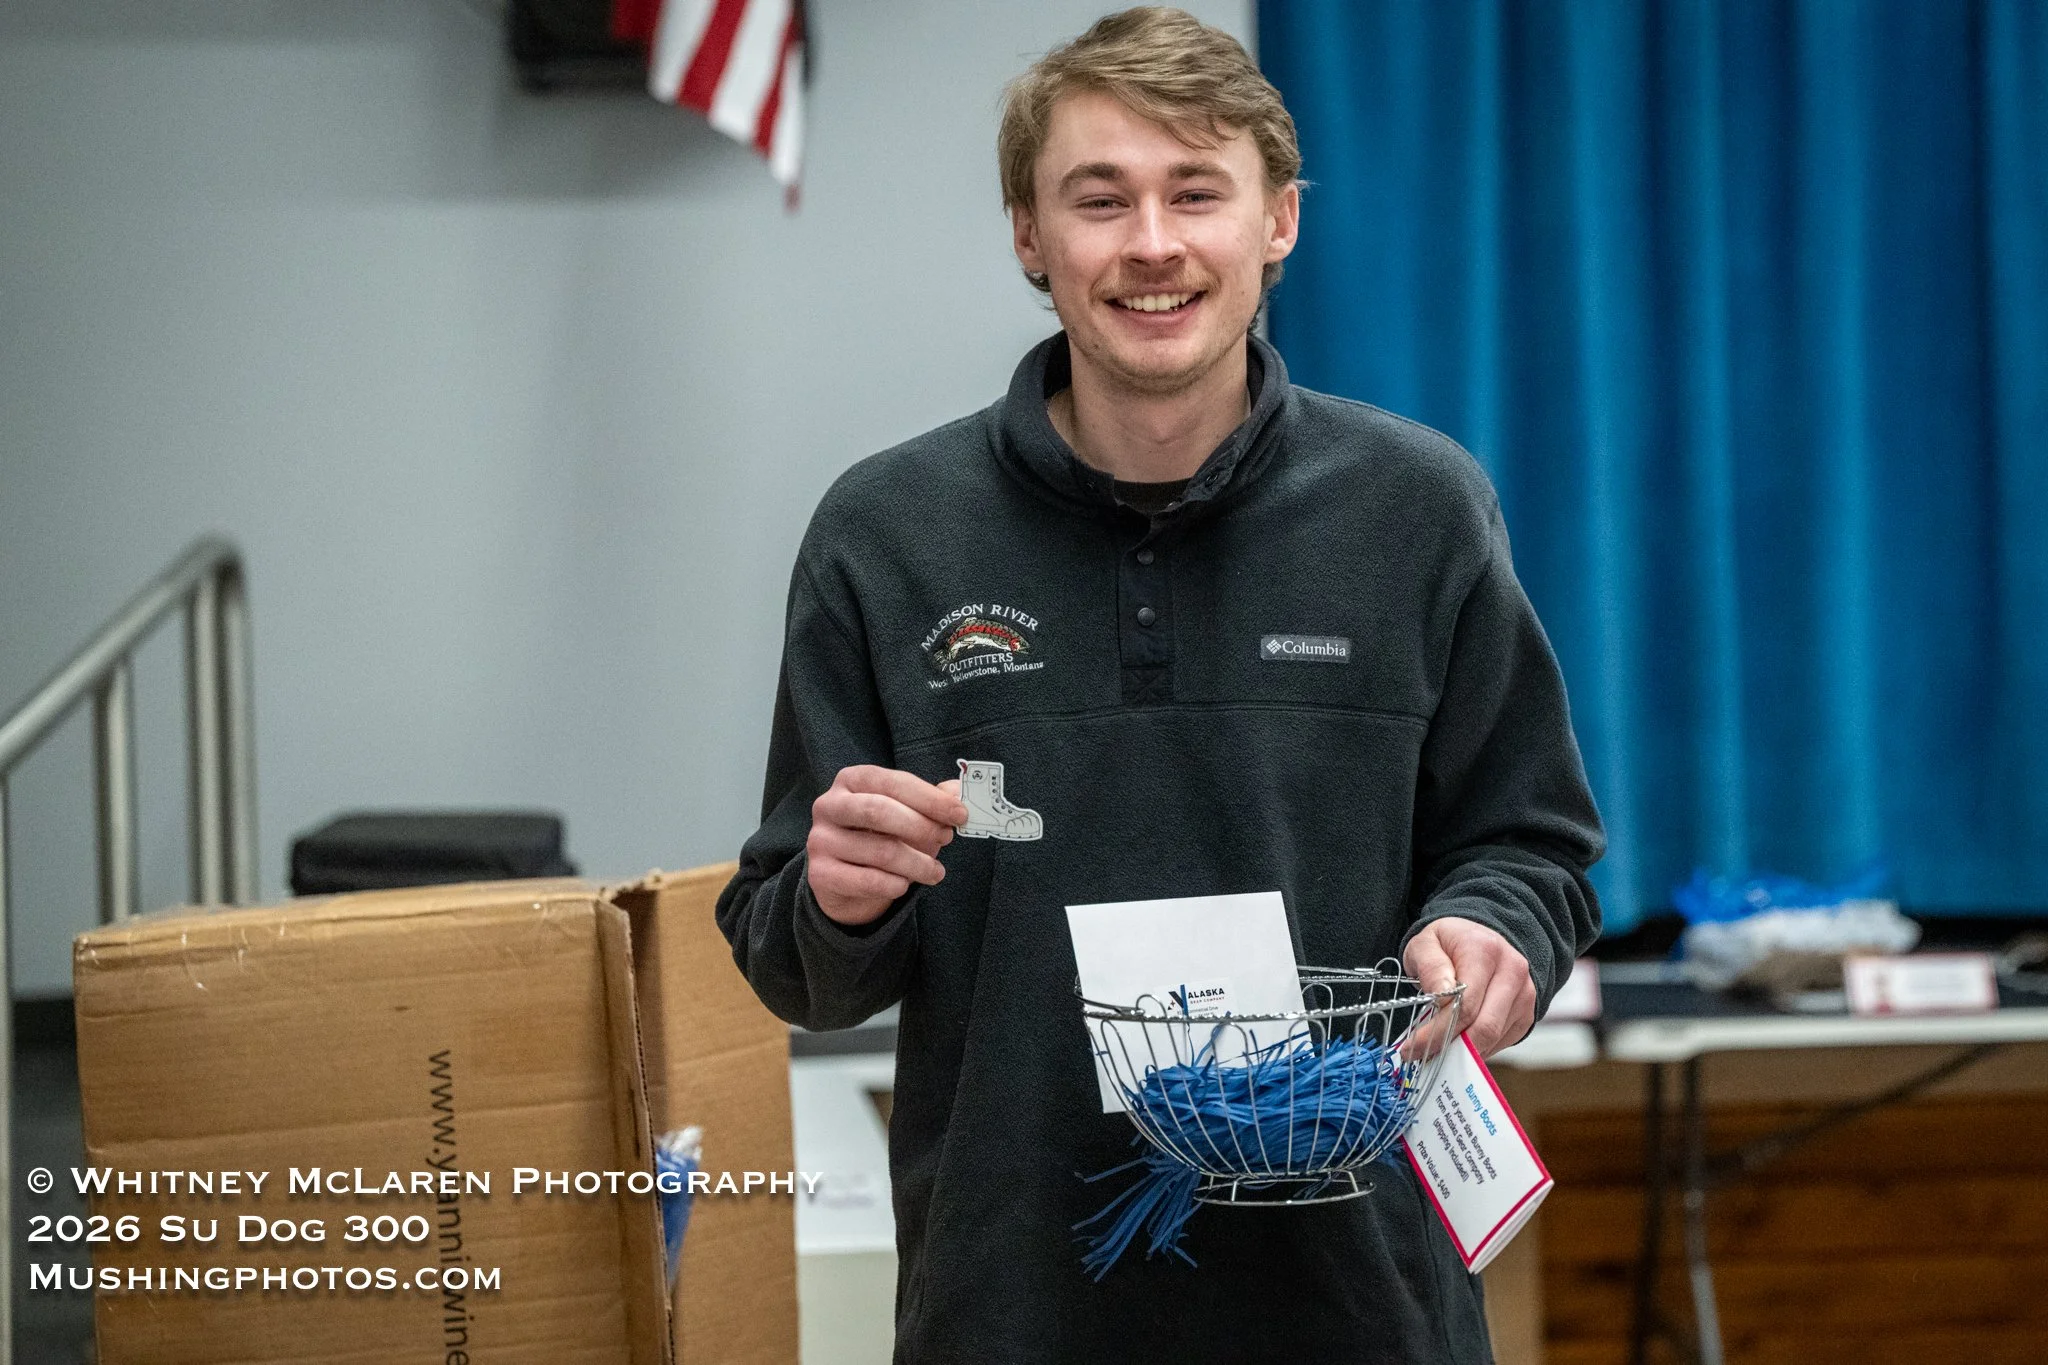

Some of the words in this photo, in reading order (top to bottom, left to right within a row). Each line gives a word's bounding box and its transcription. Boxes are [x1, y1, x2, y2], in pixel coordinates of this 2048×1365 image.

[921, 604, 984, 651] MADISON
[990, 604, 1039, 631] RIVER
[1282, 640, 1346, 656] Columbia
[949, 652, 1014, 673] OUTFITTERS
[1188, 988, 1225, 999] ALASKA
[1442, 1087, 1454, 1102] pair
[1453, 1107, 1467, 1124] your
[1463, 1123, 1474, 1139] size
[1470, 1135, 1486, 1161] Bunny
[1482, 1156, 1499, 1180] Boots
[1465, 1083, 1484, 1113] Bunny
[1479, 1109, 1498, 1137] Boots
[1432, 1117, 1452, 1152] (shipping
[1435, 1094, 1447, 1115] from
[1443, 1112, 1459, 1137] Alaska
[1455, 1133, 1468, 1153] Gear
[1464, 1150, 1485, 1185] Company
[1416, 1140, 1429, 1160] Prize
[1425, 1156, 1441, 1182] Value:
[1437, 1179, 1451, 1200] $400
